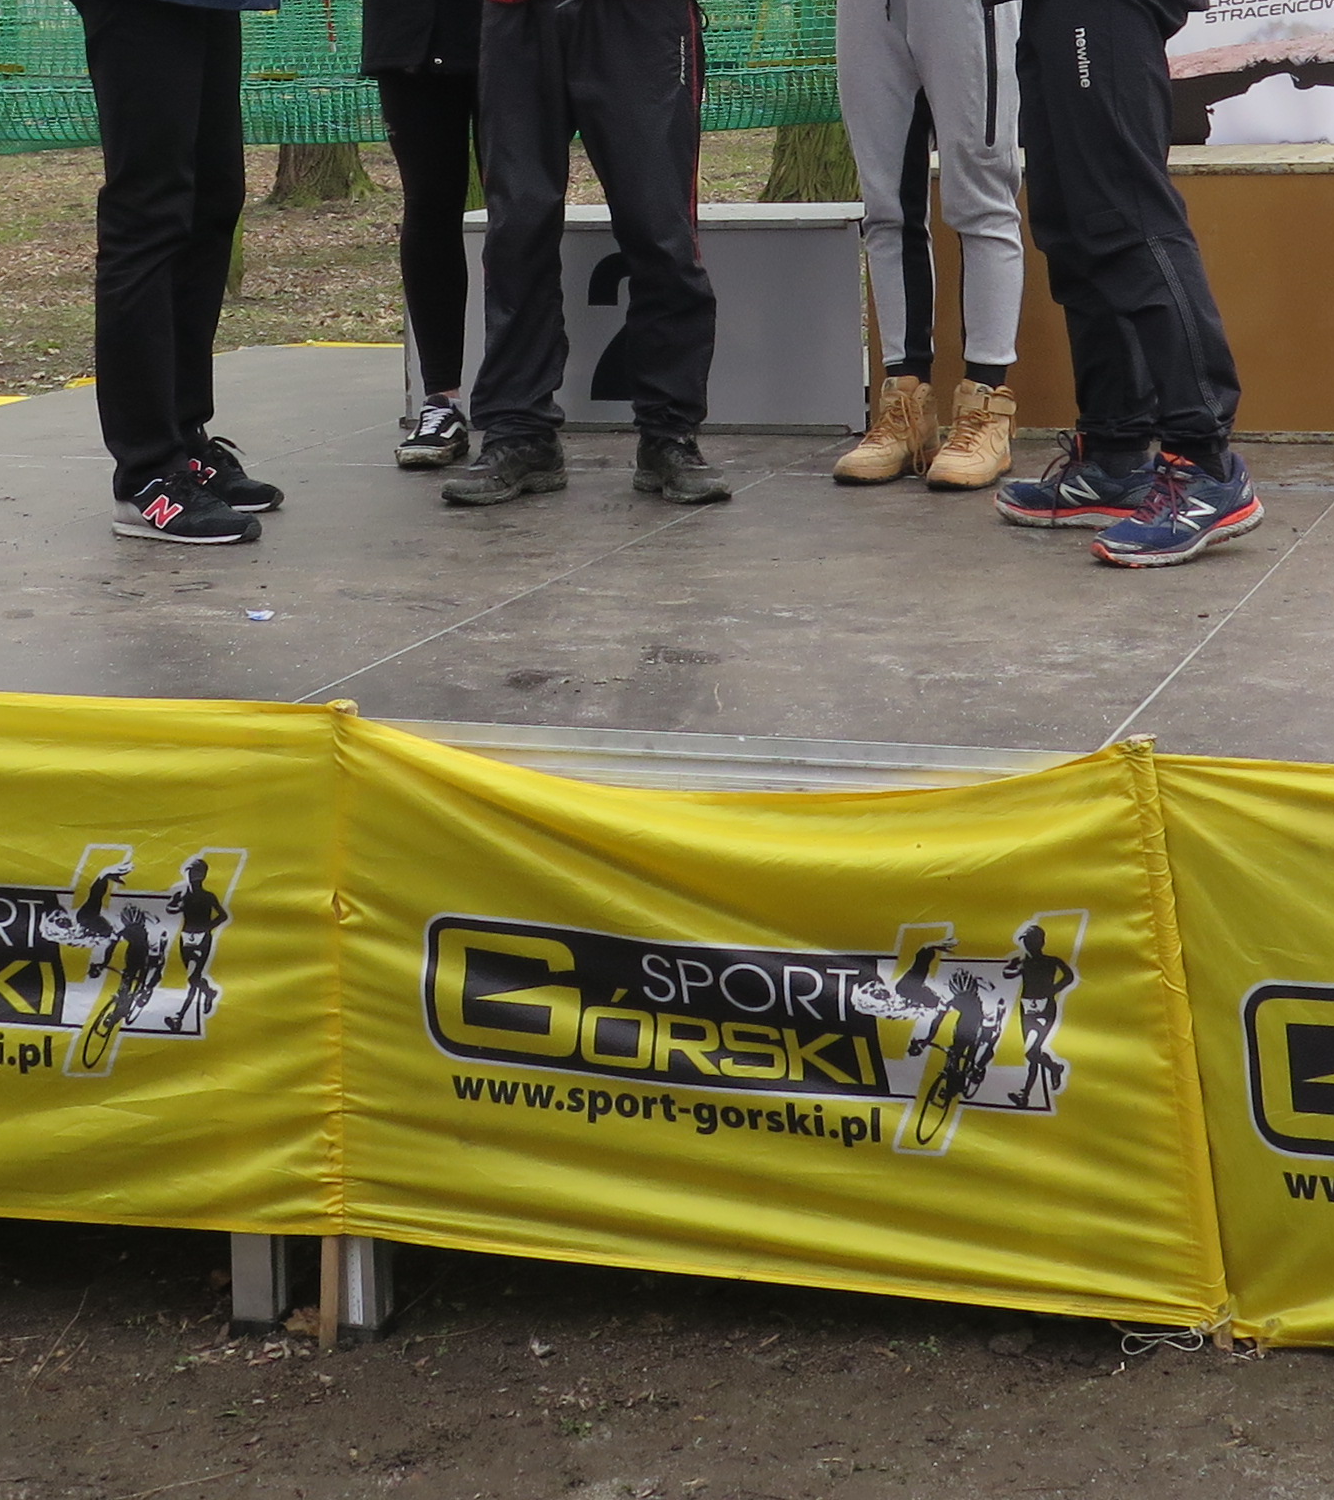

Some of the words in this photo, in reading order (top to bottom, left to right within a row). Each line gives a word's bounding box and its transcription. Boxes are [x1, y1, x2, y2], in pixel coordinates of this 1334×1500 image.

[1074, 27, 1091, 88] newline
[434, 926, 876, 1086] GÓRSKI
[641, 953, 860, 1022] SPORT
[452, 1073, 882, 1148] www.sport-gorski.pl
